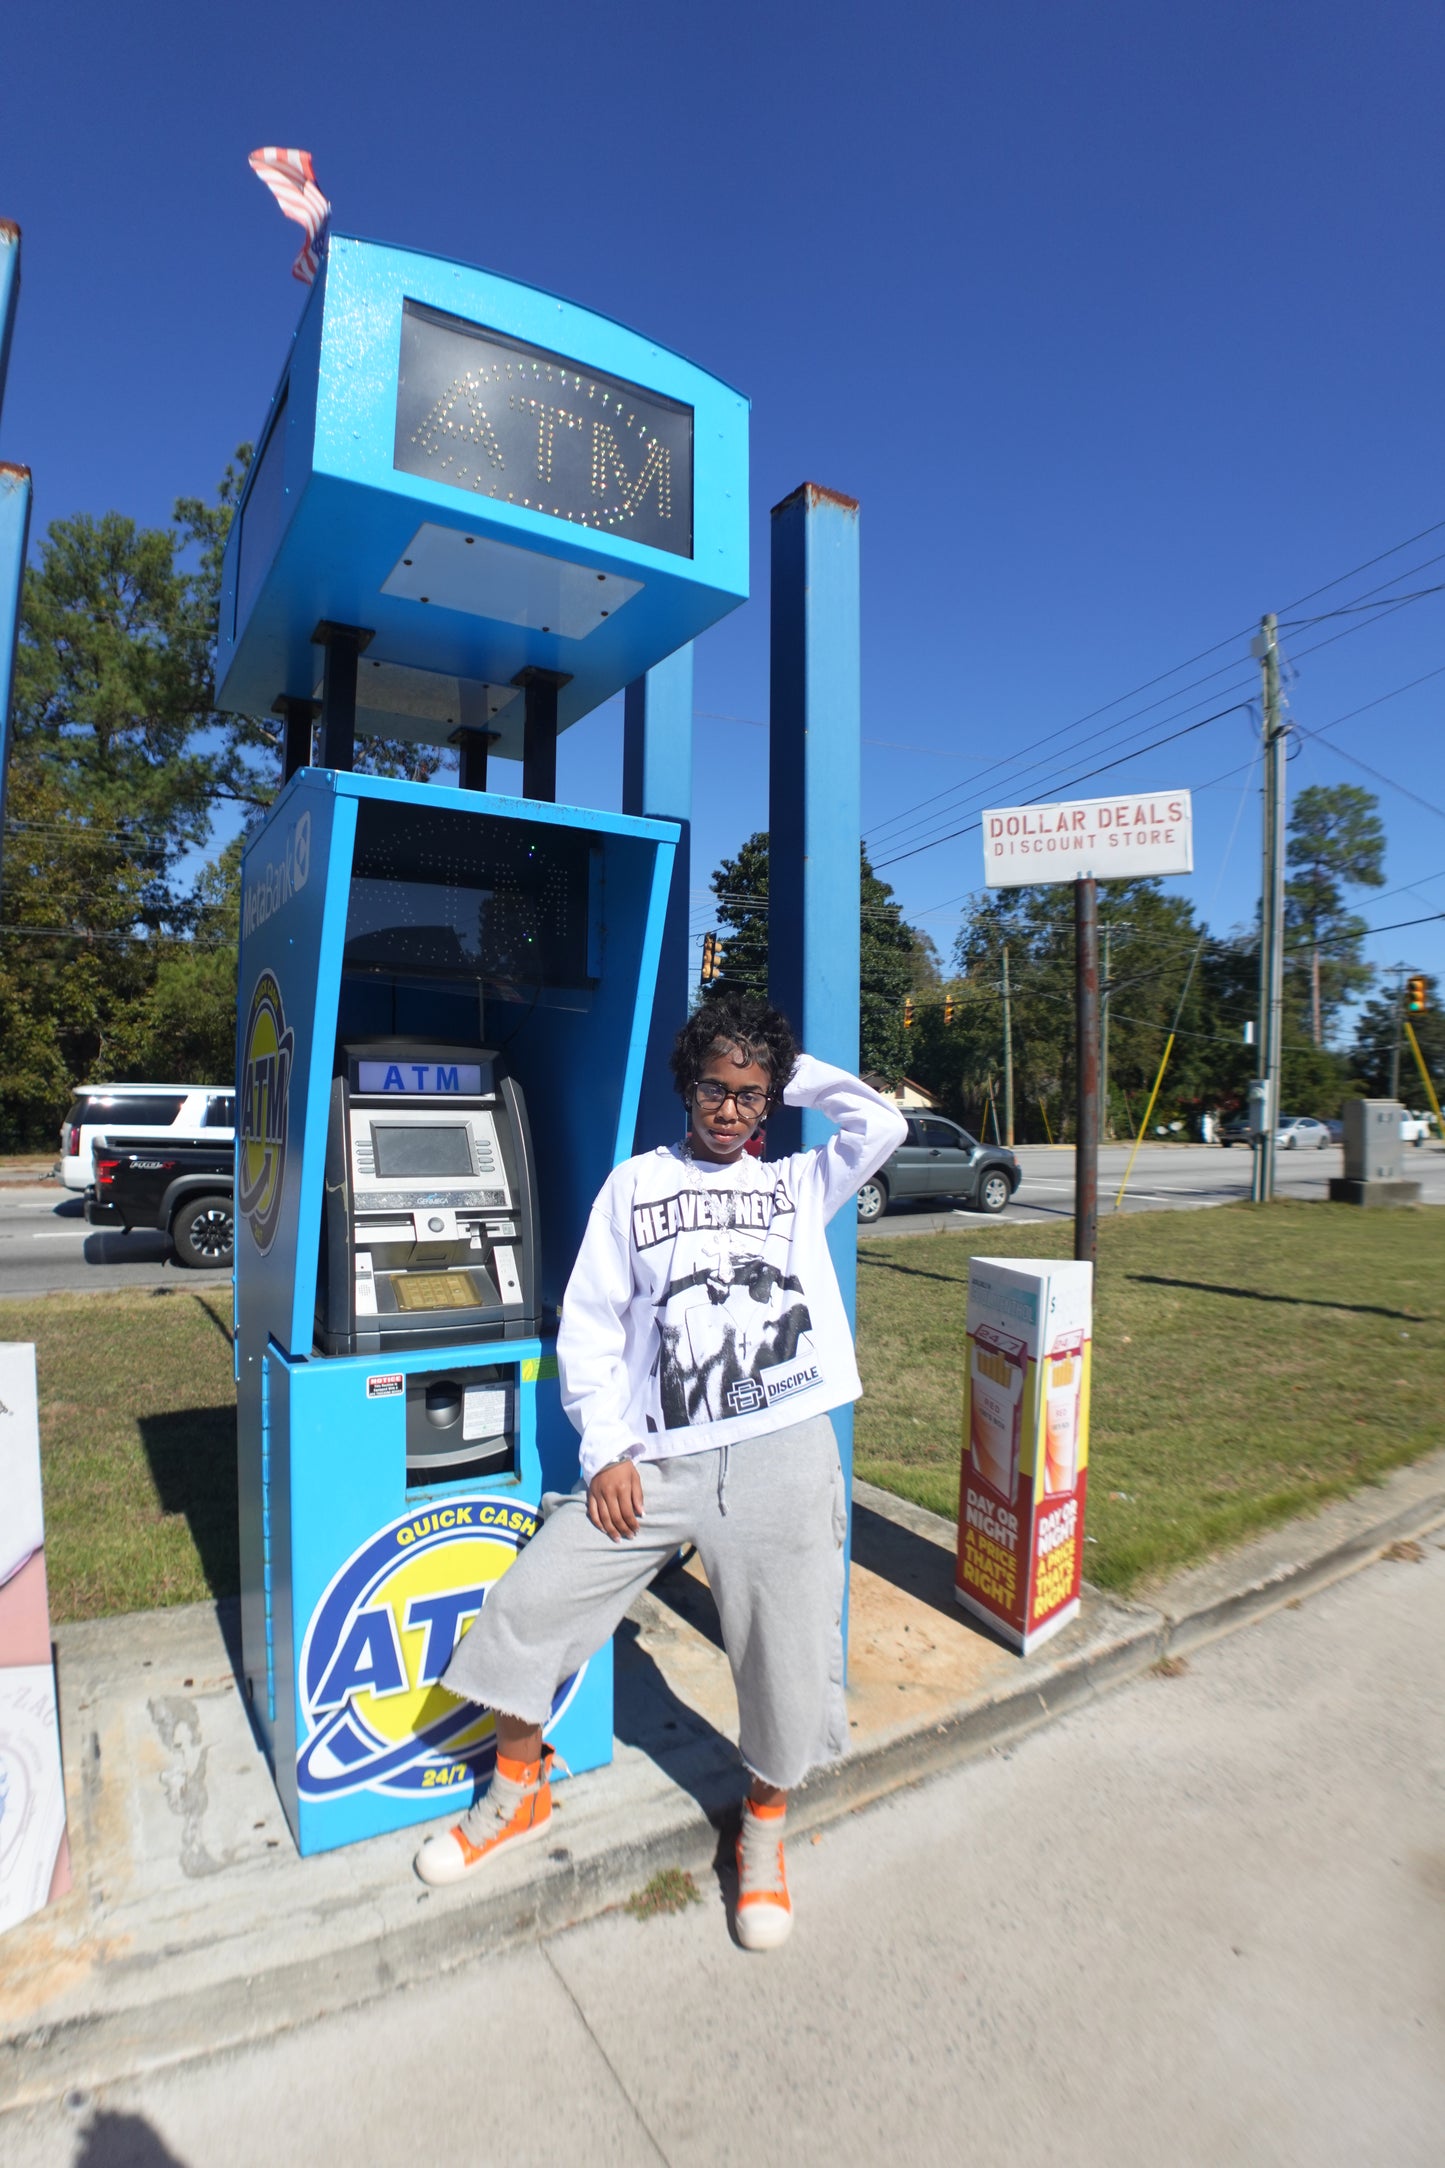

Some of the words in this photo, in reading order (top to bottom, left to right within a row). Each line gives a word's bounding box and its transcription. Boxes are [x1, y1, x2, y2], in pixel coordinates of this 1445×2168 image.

[409, 380, 671, 519] ATM
[990, 810, 1085, 838] DOLLAR
[1098, 801, 1183, 828] DEALS
[994, 834, 1096, 856] DISCOUNT
[1109, 829, 1175, 847] STORE
[241, 1048, 290, 1145] ATM
[383, 1065, 459, 1091] ATM
[633, 1192, 729, 1248] HEAVEN
[979, 1329, 1020, 1351] 24/7
[370, 1375, 402, 1385] NOTICE
[767, 1365, 819, 1397] DISCIPLE
[396, 1506, 473, 1546] QUICK
[479, 1506, 538, 1537] CASH
[966, 1505, 1018, 1551] NIGHT
[967, 1488, 995, 1517] DAY
[997, 1507, 1018, 1532] OR
[1038, 1508, 1062, 1536] DAY
[1062, 1498, 1078, 1519] OR
[965, 1528, 976, 1545] A
[978, 1535, 1017, 1573] PRICE
[1037, 1515, 1077, 1557] NIGHT
[1038, 1558, 1047, 1575] A
[1047, 1536, 1076, 1570] PRICE
[963, 1560, 1017, 1610] RIGHT
[965, 1544, 1017, 1591] THAT'S
[1036, 1556, 1075, 1596] THAT'S
[1033, 1576, 1073, 1619] RIGHT
[306, 1584, 489, 1710] AT
[421, 1763, 467, 1787] 24/7
